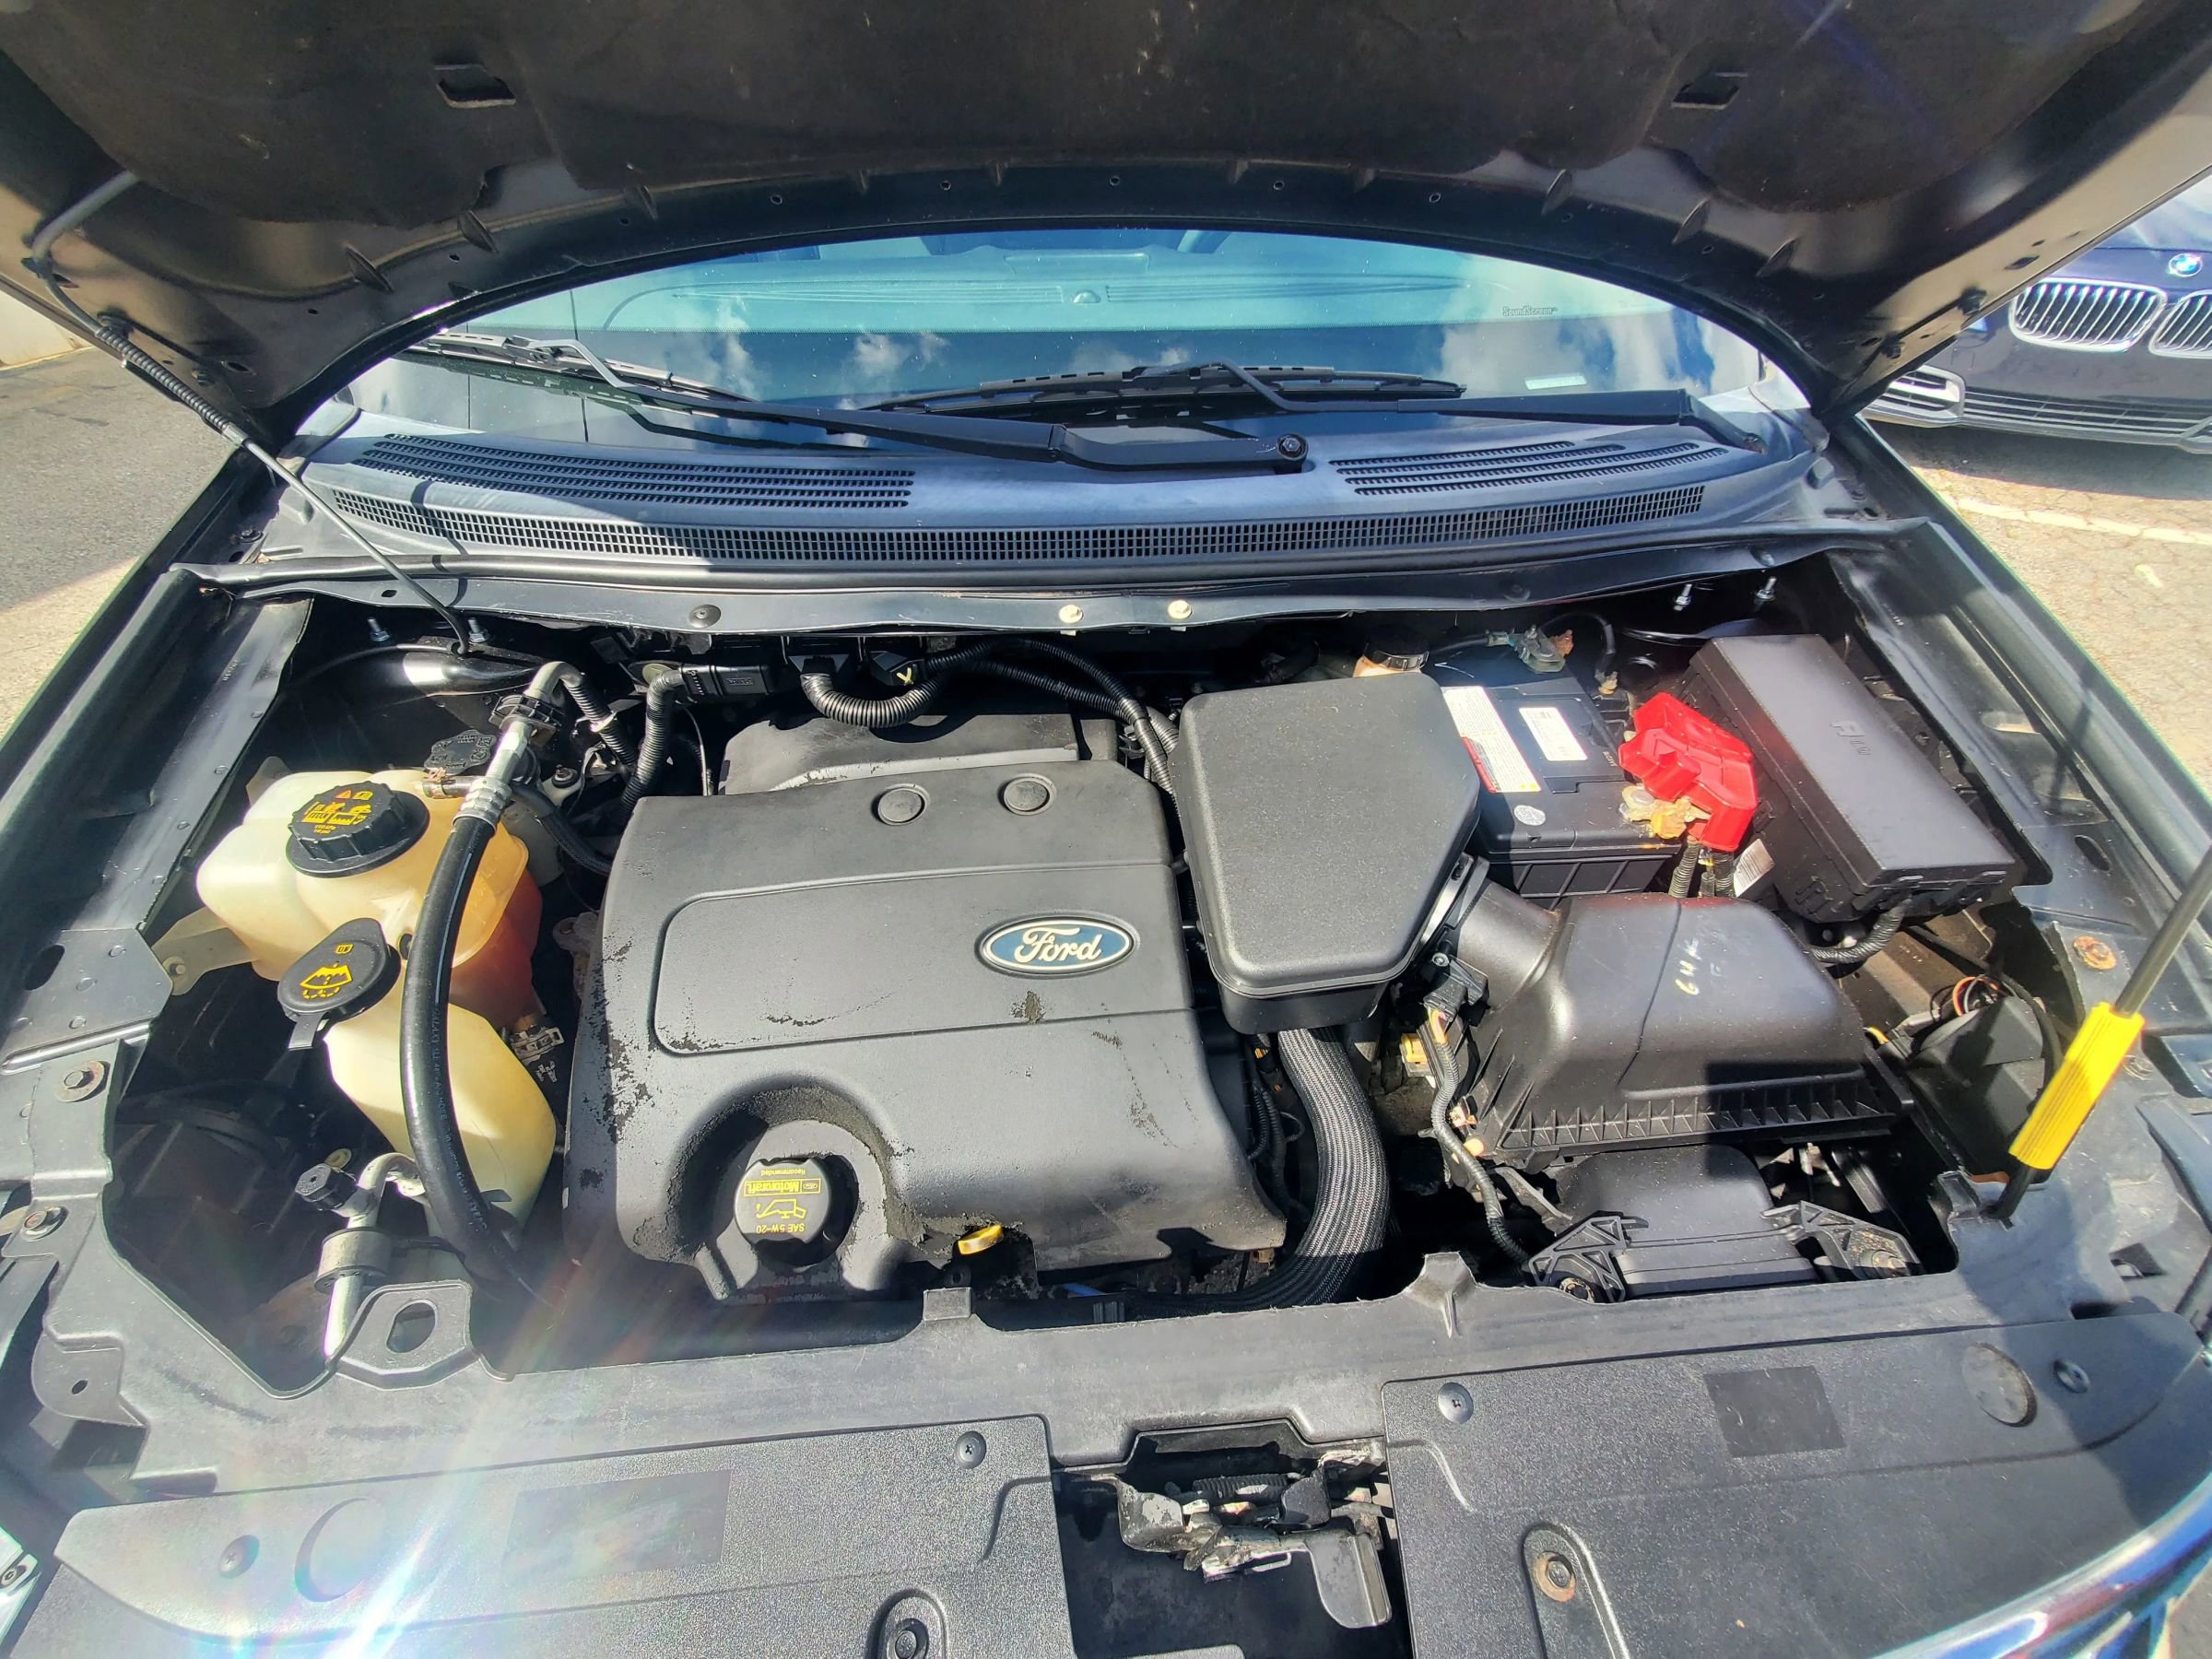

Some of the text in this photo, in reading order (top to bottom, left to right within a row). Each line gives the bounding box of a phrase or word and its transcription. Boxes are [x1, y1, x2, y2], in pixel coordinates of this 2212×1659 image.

[1014, 927, 1102, 962] Ford
[760, 1168, 806, 1177] Recommended
[747, 1181, 800, 1194] Motorcraft
[787, 1223, 806, 1232] SAE
